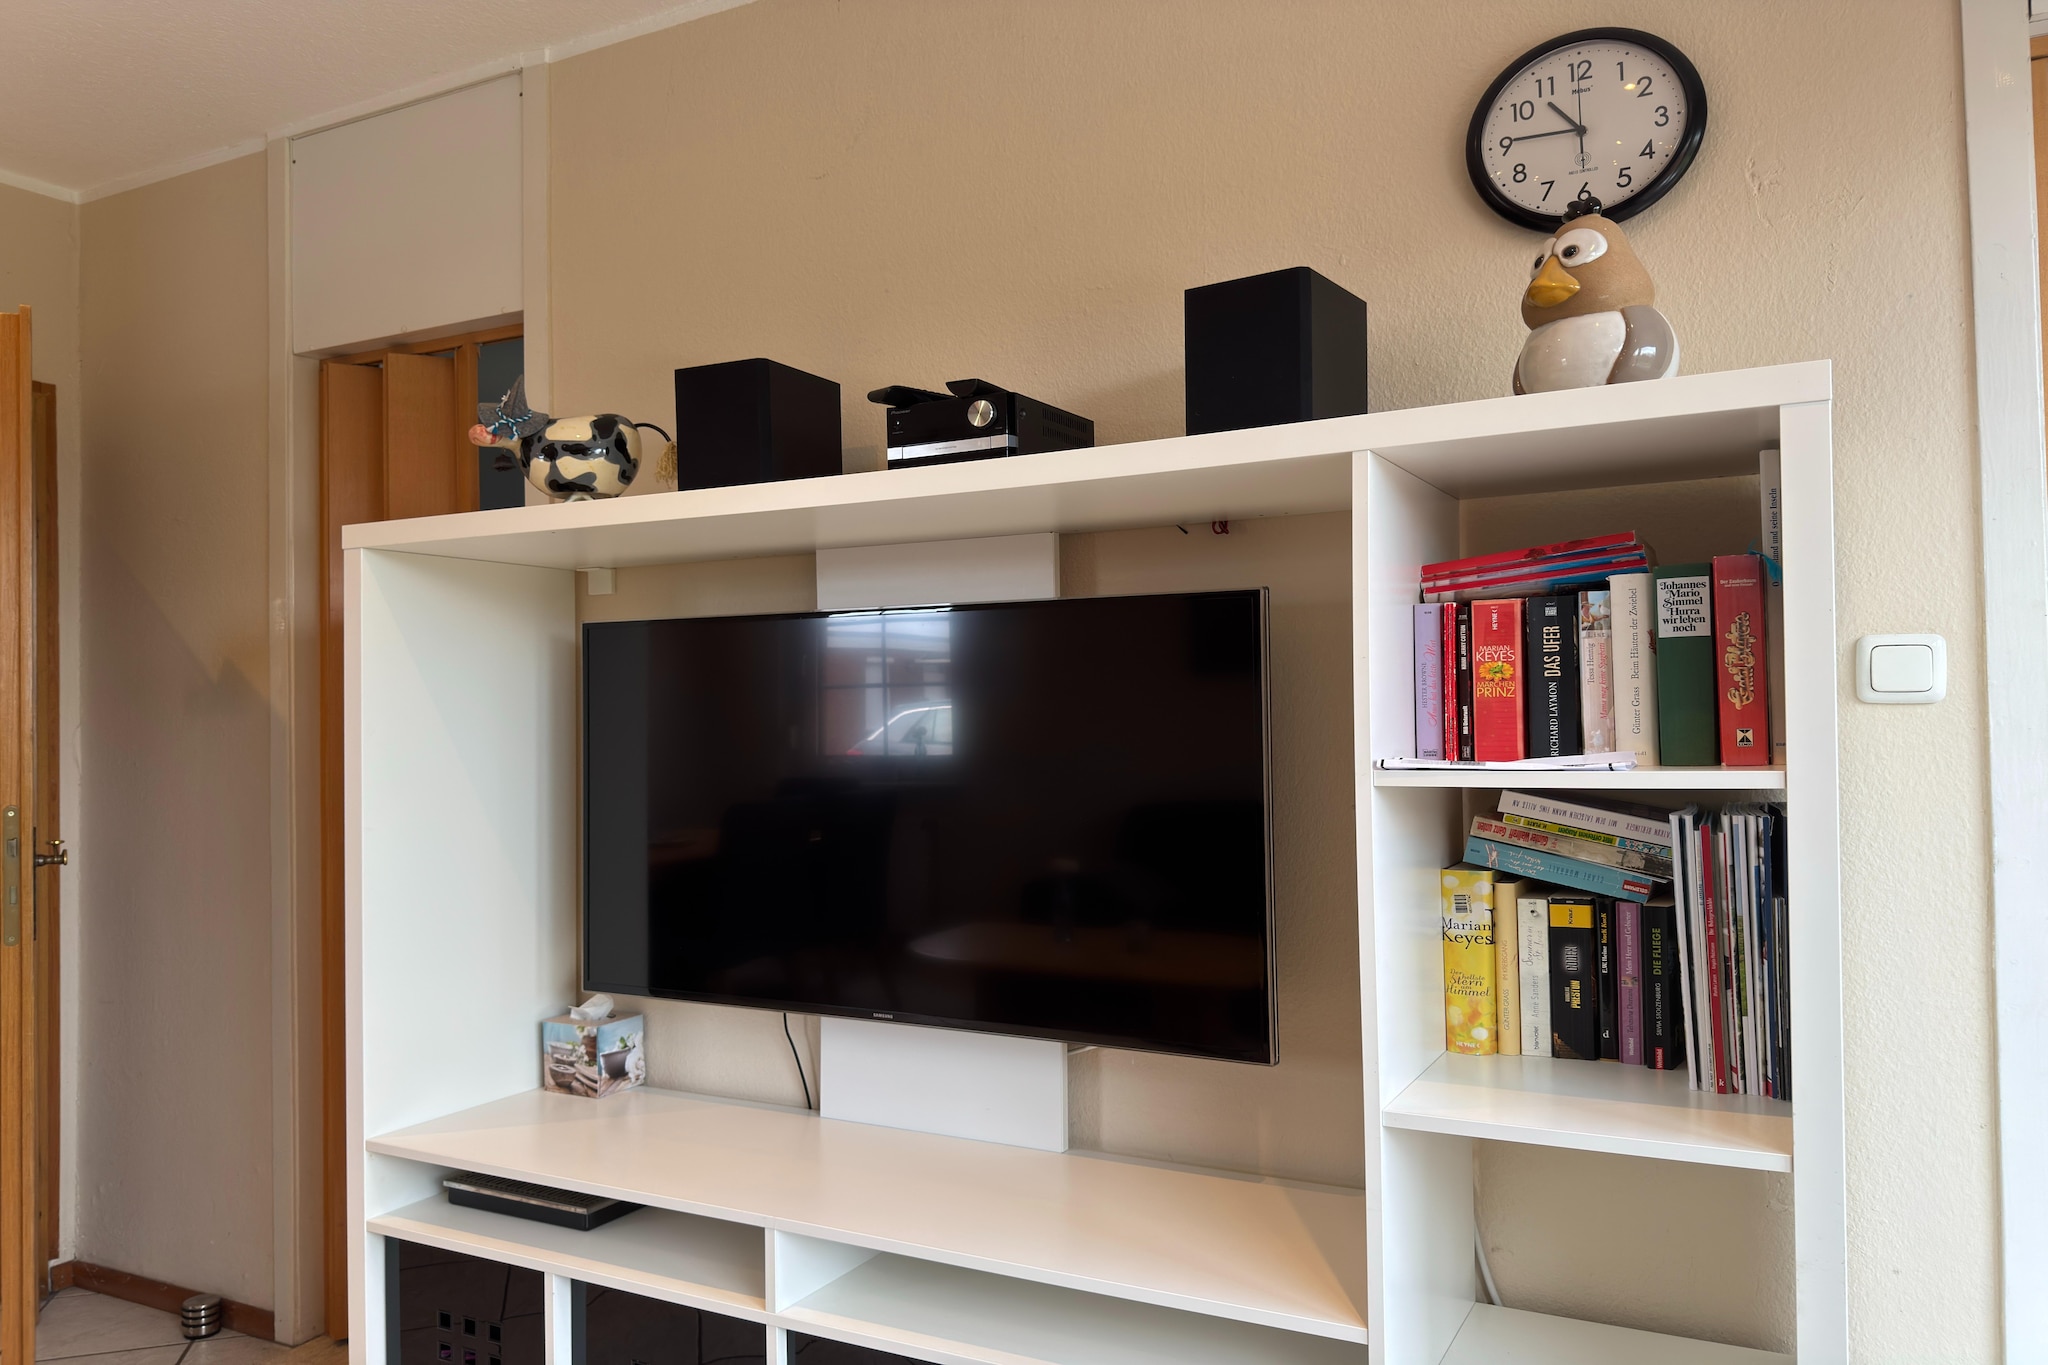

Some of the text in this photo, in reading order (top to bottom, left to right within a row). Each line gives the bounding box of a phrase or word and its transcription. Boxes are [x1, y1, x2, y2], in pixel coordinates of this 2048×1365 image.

[1567, 60, 1593, 82] 12
[1616, 61, 1624, 81] 1
[1535, 76, 1555, 98] 11
[1636, 76, 1653, 98] 2
[1510, 100, 1535, 122] 10
[1654, 105, 1669, 127] 3
[1499, 136, 1513, 157] 9
[1638, 138, 1656, 160] 4
[1512, 163, 1527, 183] 8
[1616, 166, 1633, 188] 5
[1540, 180, 1555, 202] 7
[1577, 181, 1592, 201] 6
[1769, 488, 1778, 509] Inseln
[1770, 512, 1778, 529] seine
[1770, 531, 1778, 545] und
[1659, 580, 1707, 591] Johannes
[1665, 588, 1700, 599] Mario
[1662, 597, 1703, 608] Simmel
[1666, 607, 1700, 616] Hurra
[1662, 615, 1706, 625] wir leben
[1672, 624, 1696, 633] noch
[1543, 625, 1561, 653] UFER
[1629, 588, 1639, 680] Beim Häuten der Zwiebel
[1476, 650, 1515, 662] KEYES
[1544, 653, 1561, 678] DAS
[1586, 643, 1595, 685] Tessa Hennig
[1598, 642, 1608, 669] Spaghetti
[1724, 612, 1756, 710] Enid Blyton
[1477, 687, 1515, 698] PRINZ
[1600, 686, 1609, 699] mag
[1549, 681, 1559, 756] RICHARD LAYMON
[1632, 686, 1641, 734] Günter Grass
[1512, 799, 1618, 827] MIT DEM FALSCHEN MANN FING ALLES AN
[1492, 825, 1507, 838] Ganz
[1507, 827, 1531, 843] Wallraff
[1530, 832, 1549, 847] Günter
[1582, 872, 1604, 884] CLARE
[1623, 884, 1649, 894] GOLDMANN
[1442, 916, 1491, 931] Marian
[1442, 929, 1493, 950] Keyes
[1565, 945, 1579, 972] CODEX
[1652, 927, 1661, 975] DIE FLIEGE
[1449, 974, 1484, 987] Stern
[1461, 971, 1485, 981] hellste
[1446, 984, 1490, 997] Himmel
[1530, 975, 1539, 1018] Anne Sanders
[1570, 979, 1581, 1009] PRESTON
[1654, 982, 1662, 1020] STOLZENBURG
[1502, 988, 1510, 1031] GÜNTER GRASS
